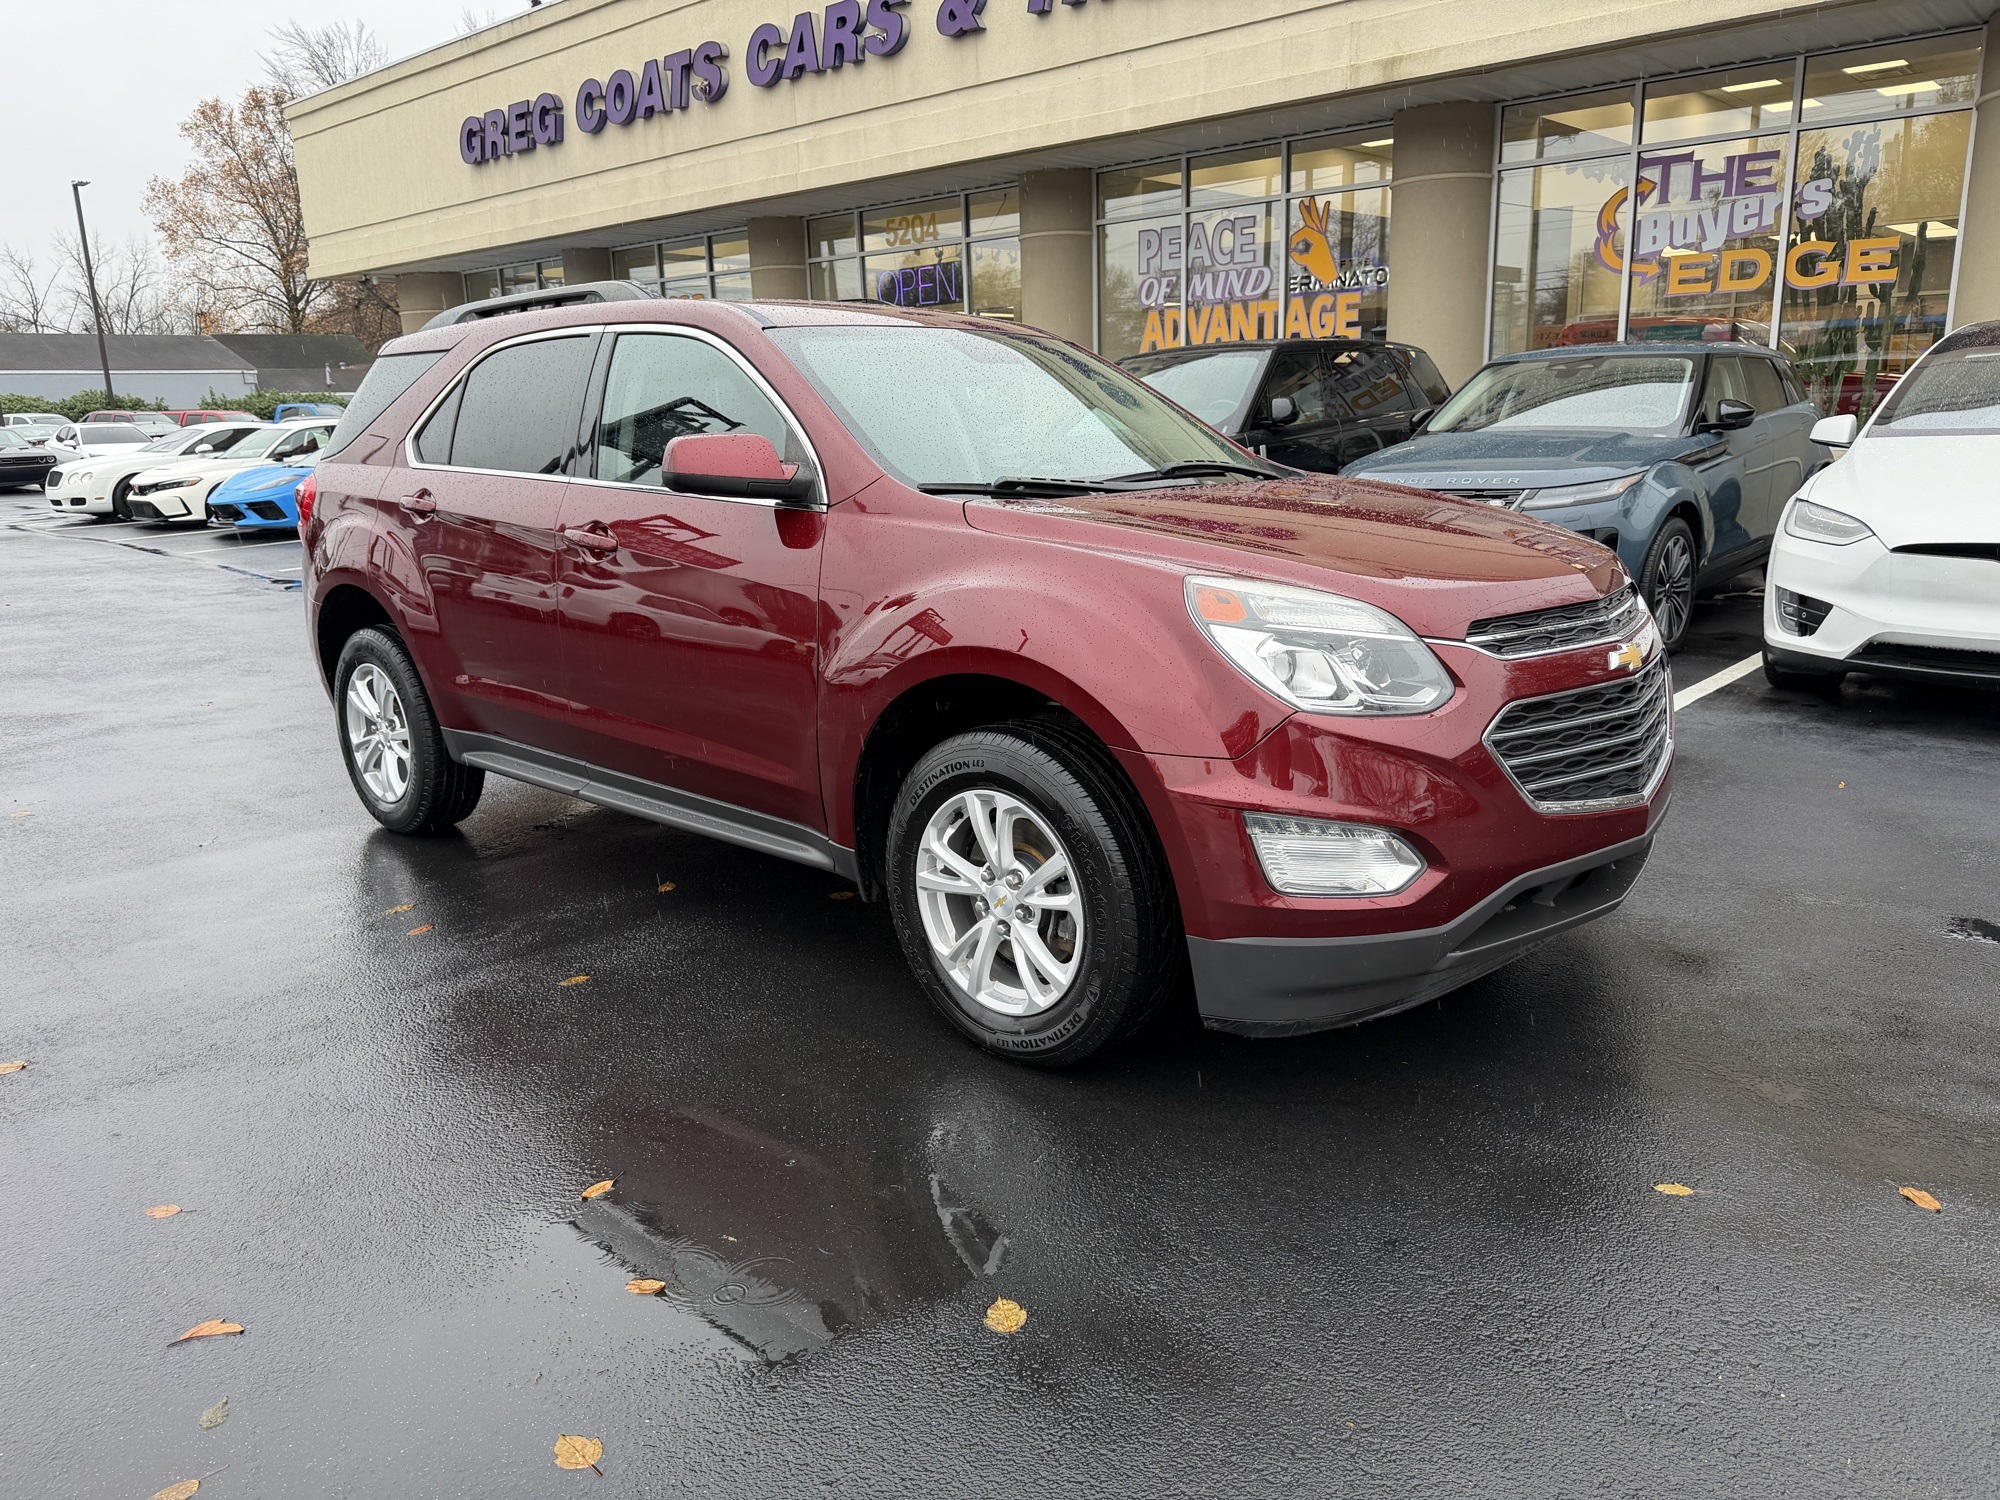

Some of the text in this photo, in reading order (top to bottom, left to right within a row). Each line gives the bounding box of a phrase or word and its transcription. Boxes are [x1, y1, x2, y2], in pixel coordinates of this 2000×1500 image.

[460, 0, 988, 165] GREG COATS CARS &
[1640, 150, 1781, 207] THE
[885, 213, 938, 247] 5204
[1637, 178, 1833, 256] Buyer's
[1138, 215, 1257, 275] PEACE
[1665, 236, 1901, 297] EDGE
[878, 263, 956, 307] OPEN
[1138, 265, 1272, 309] OF MIND
[1139, 291, 1362, 353] ADVANTAGE
[1446, 476, 1520, 485] ROVER
[909, 759, 971, 807] DESTINATION
[971, 759, 985, 768] LE3
[996, 1011, 1084, 1049] DESTINATION LE3
